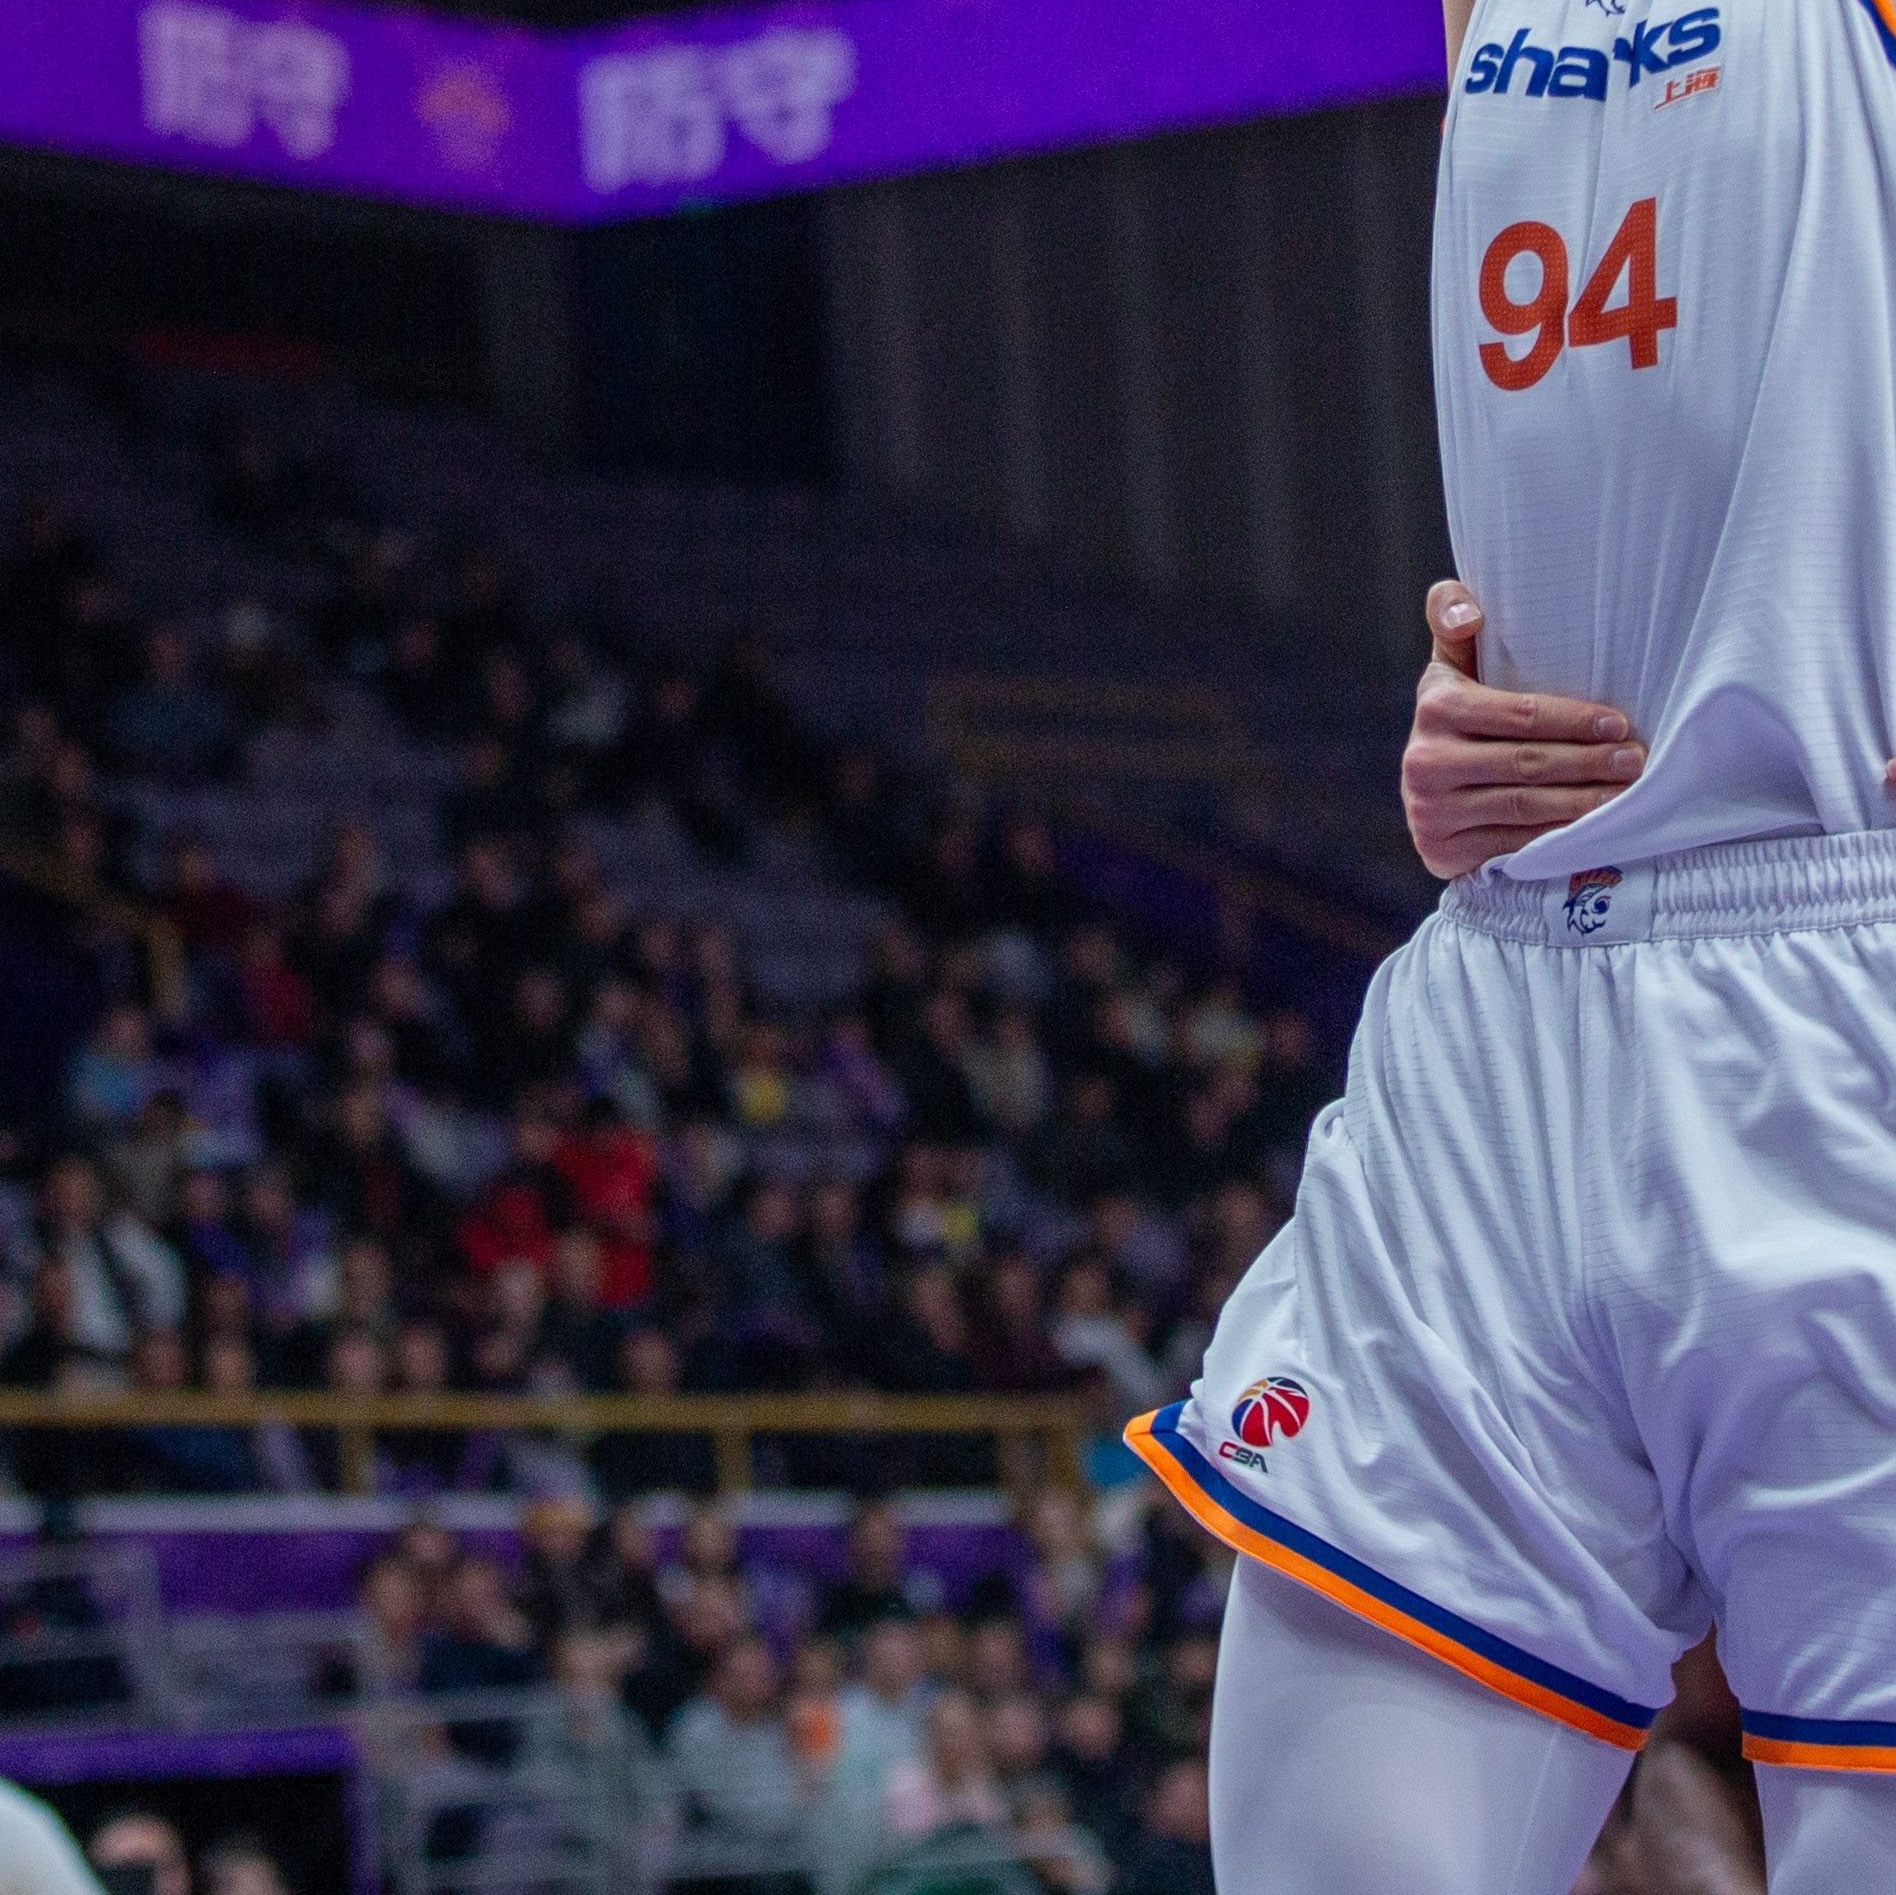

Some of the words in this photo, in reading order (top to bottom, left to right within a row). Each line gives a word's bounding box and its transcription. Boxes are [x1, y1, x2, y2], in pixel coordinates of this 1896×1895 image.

[577, 26, 857, 194] 防守
[1654, 66, 1722, 110] 上海
[1478, 196, 1677, 391] 94
[1219, 1441, 1269, 1474] CBA
